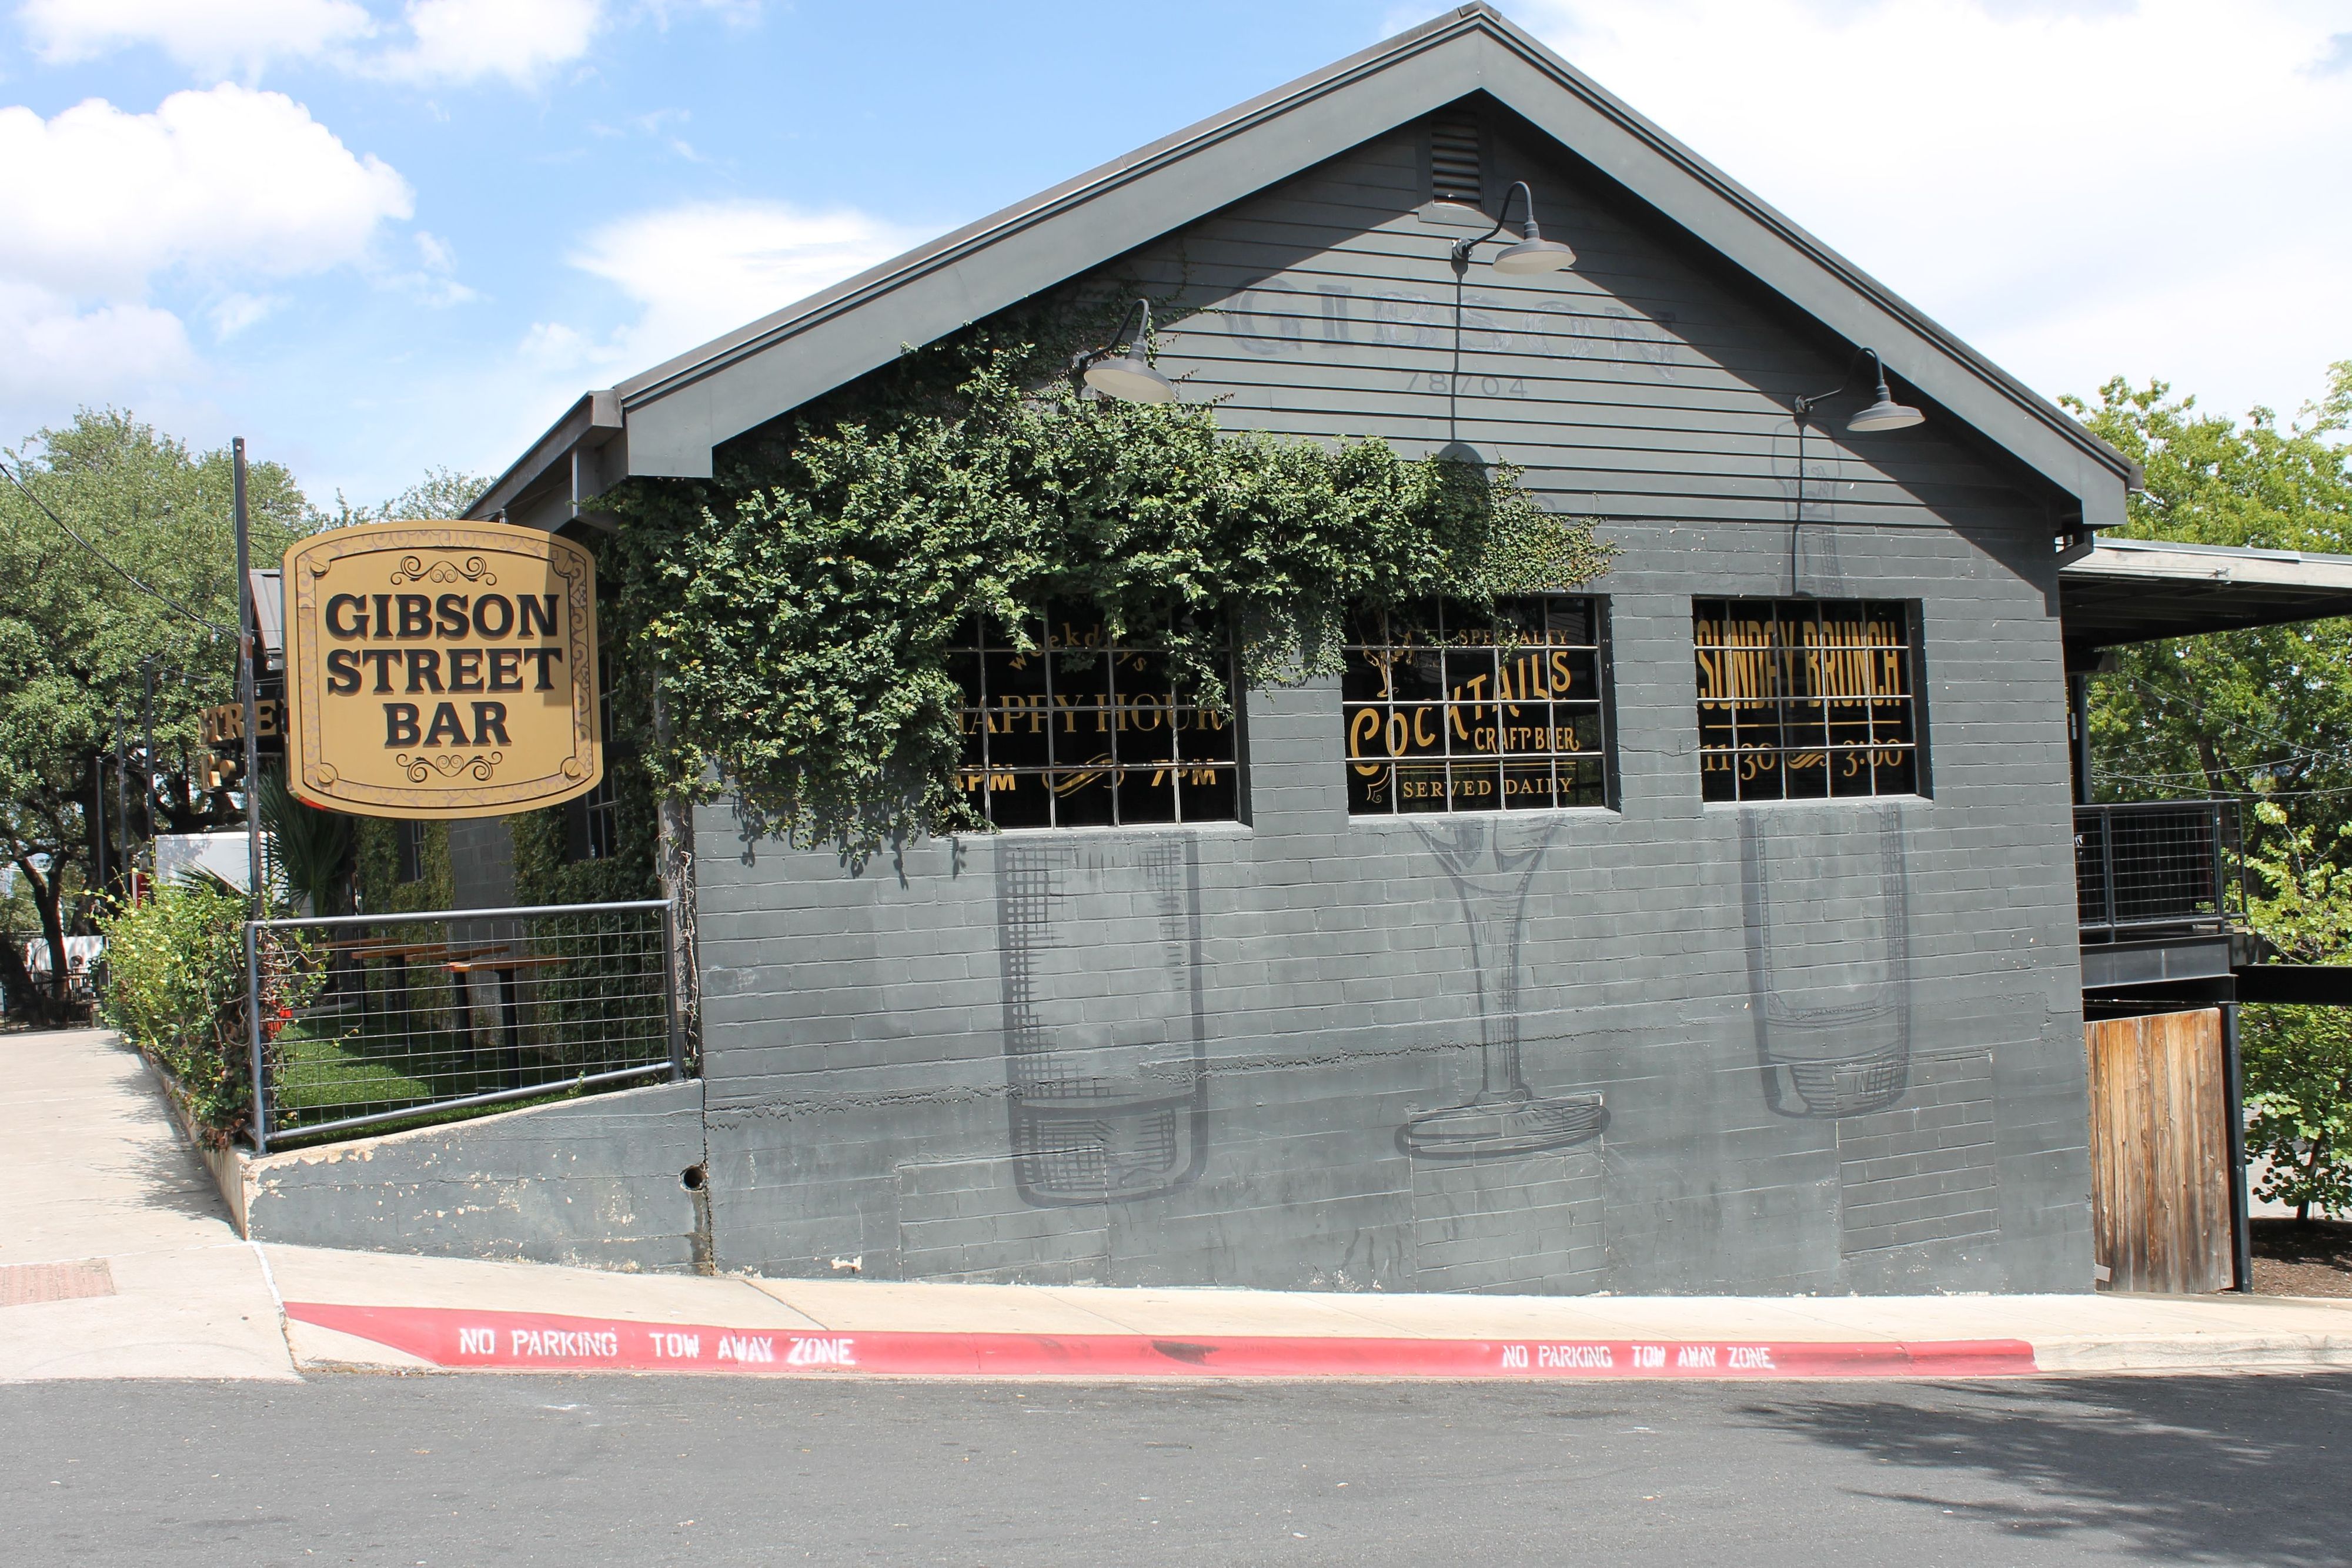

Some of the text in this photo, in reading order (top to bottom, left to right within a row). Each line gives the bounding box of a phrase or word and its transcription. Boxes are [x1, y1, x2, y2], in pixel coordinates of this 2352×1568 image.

[326, 593, 559, 641] GIBSON
[327, 648, 563, 696] STREET
[1697, 620, 1901, 710] SUNDAY BRUNCH
[383, 701, 512, 749] BAR
[1474, 727, 1580, 754] CRAFT BEER
[1151, 759, 1216, 787] 7PM
[1842, 738, 1903, 777] 3:00
[1403, 777, 1573, 798] SERVED DAILY
[459, 1328, 856, 1365] NO PARKING TOW AWAY ZONE
[1502, 1345, 1776, 1369] NO PARKING TOW AWAY ZONE
